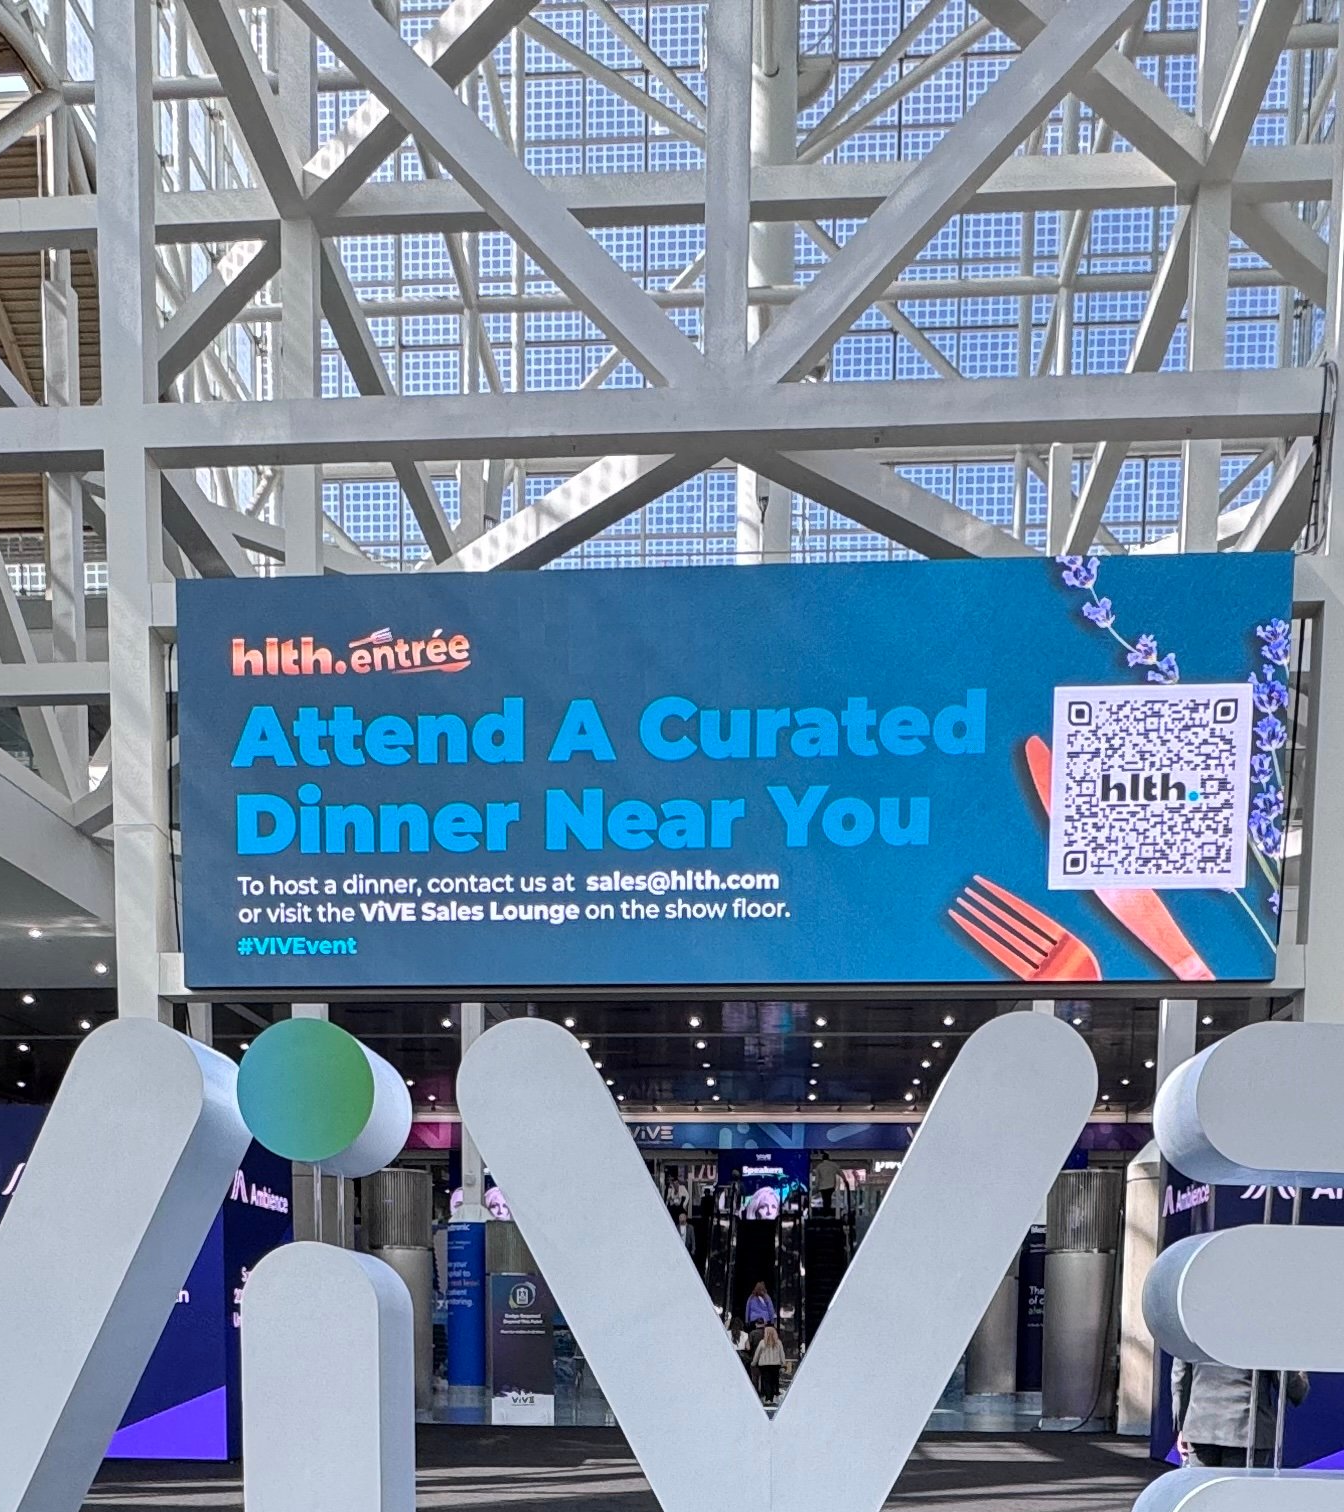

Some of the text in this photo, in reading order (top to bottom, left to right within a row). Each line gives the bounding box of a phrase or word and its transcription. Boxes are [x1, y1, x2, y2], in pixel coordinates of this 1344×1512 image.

[231, 688, 987, 767] Attend A Curated
[237, 783, 930, 854] Dinner Near You
[237, 869, 779, 897] To host a dinner, contact us at sales@hlth.com
[238, 897, 791, 925] or visit the ViVE Sales Lounge on the show floor.
[250, 1184, 288, 1214] Ambience
[1176, 1184, 1210, 1213] Ambience
